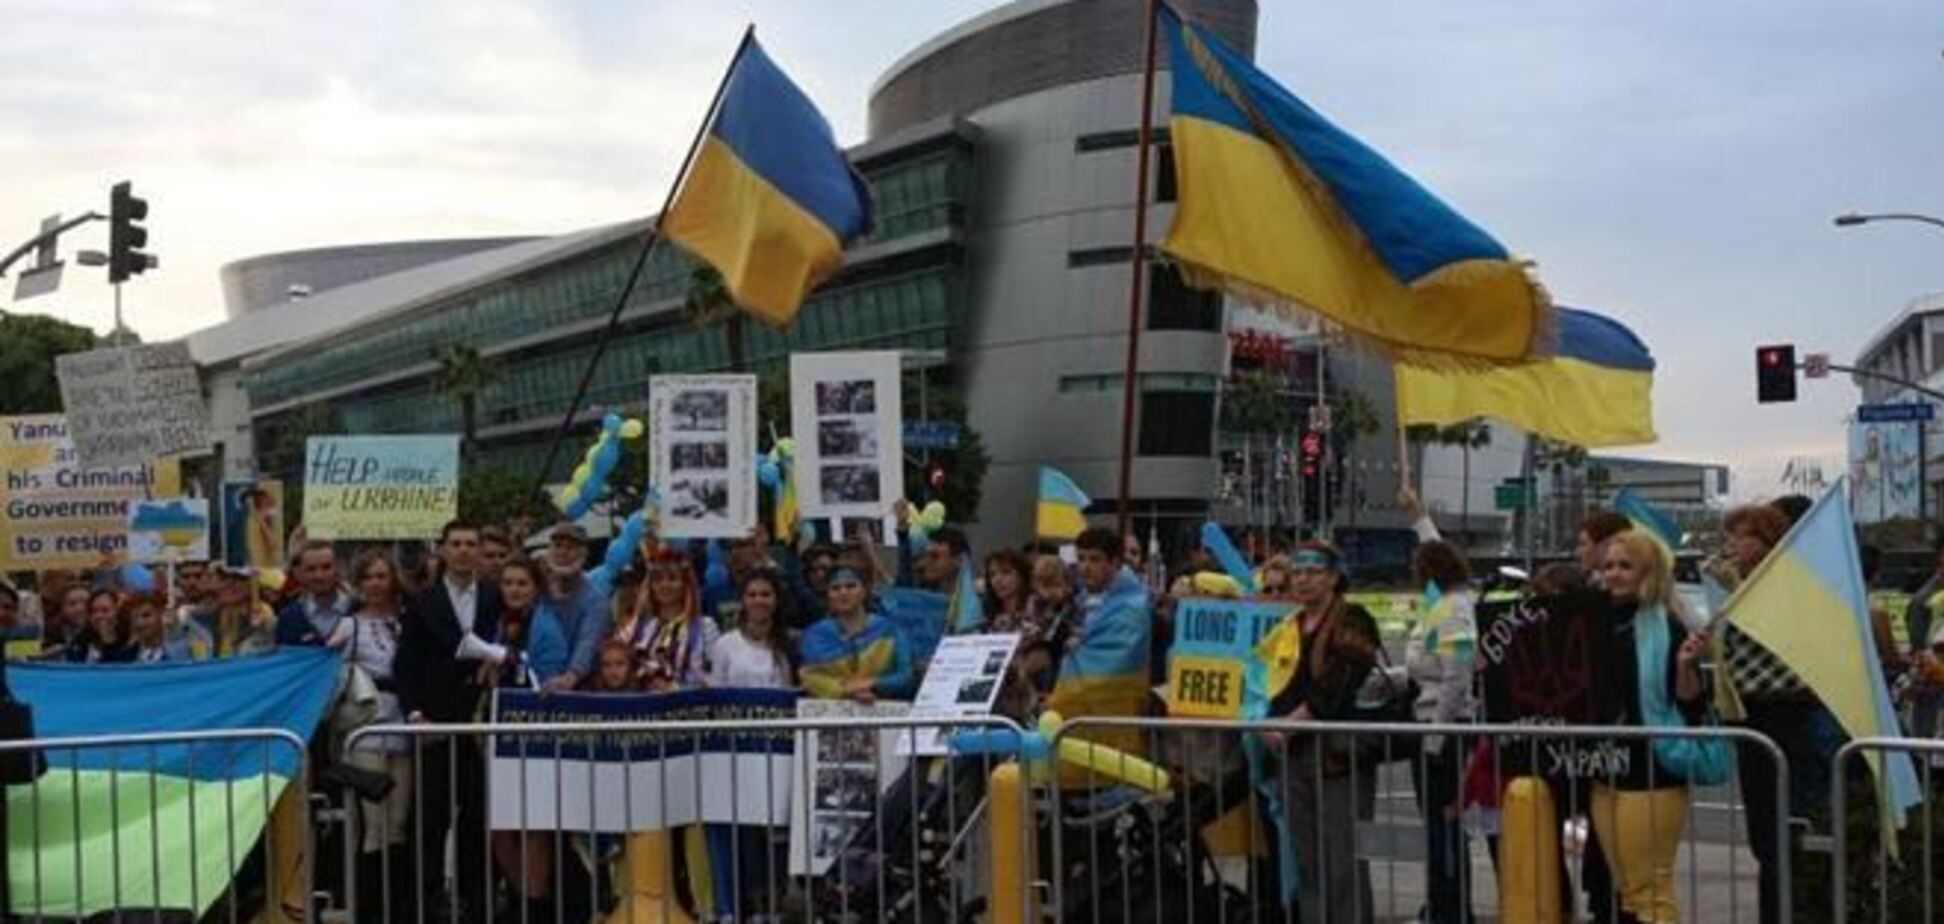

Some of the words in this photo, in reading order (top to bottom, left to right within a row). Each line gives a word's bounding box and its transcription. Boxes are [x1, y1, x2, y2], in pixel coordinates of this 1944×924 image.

[8, 469, 41, 489] his
[55, 465, 155, 487] Criminal
[311, 442, 379, 485] HELP
[16, 534, 42, 553] to
[54, 533, 127, 553] resign
[1183, 607, 1237, 643] LONG
[1178, 669, 1231, 705] FREE
